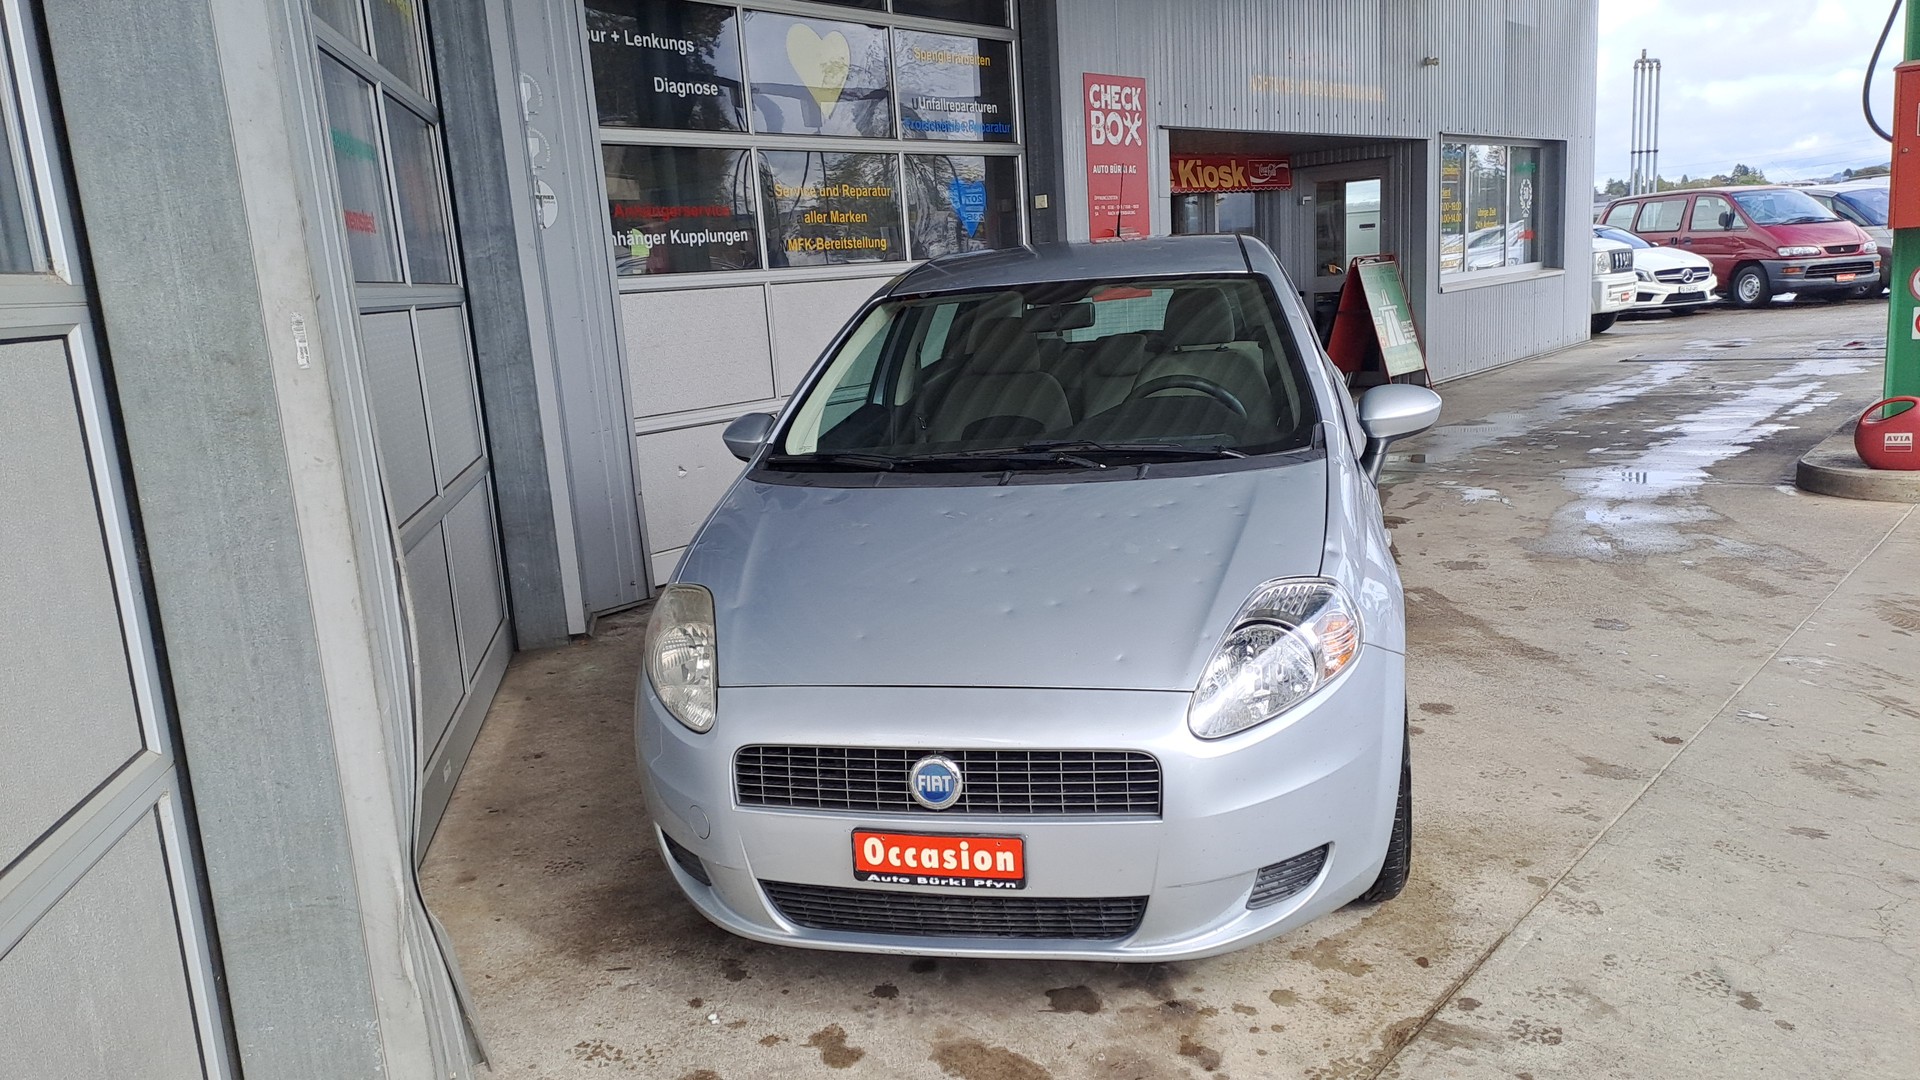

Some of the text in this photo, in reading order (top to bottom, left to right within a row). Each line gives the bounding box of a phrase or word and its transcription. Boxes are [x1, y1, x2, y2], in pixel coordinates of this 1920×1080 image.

[611, 31, 619, 41] +
[624, 30, 694, 55] Lenkungs
[913, 47, 991, 66] Spenglerarbeiten
[653, 77, 718, 97] Diagnose
[918, 97, 998, 113] Unfallreparaturen
[1089, 83, 1142, 111] CHECK
[1090, 110, 1142, 147] BOX
[1093, 164, 1109, 174] AUTO
[1128, 165, 1137, 174] AG
[1178, 160, 1247, 188] Kiosk
[774, 184, 891, 199] Service und Reparatur
[804, 210, 868, 224] aller Marken
[670, 228, 748, 248] Kupplungen
[787, 236, 887, 251] MFK-Bereitstellung
[917, 774, 952, 792] FIAT
[863, 836, 1015, 872] Occasion
[867, 874, 1017, 888] Auto Bürki Pfyn
